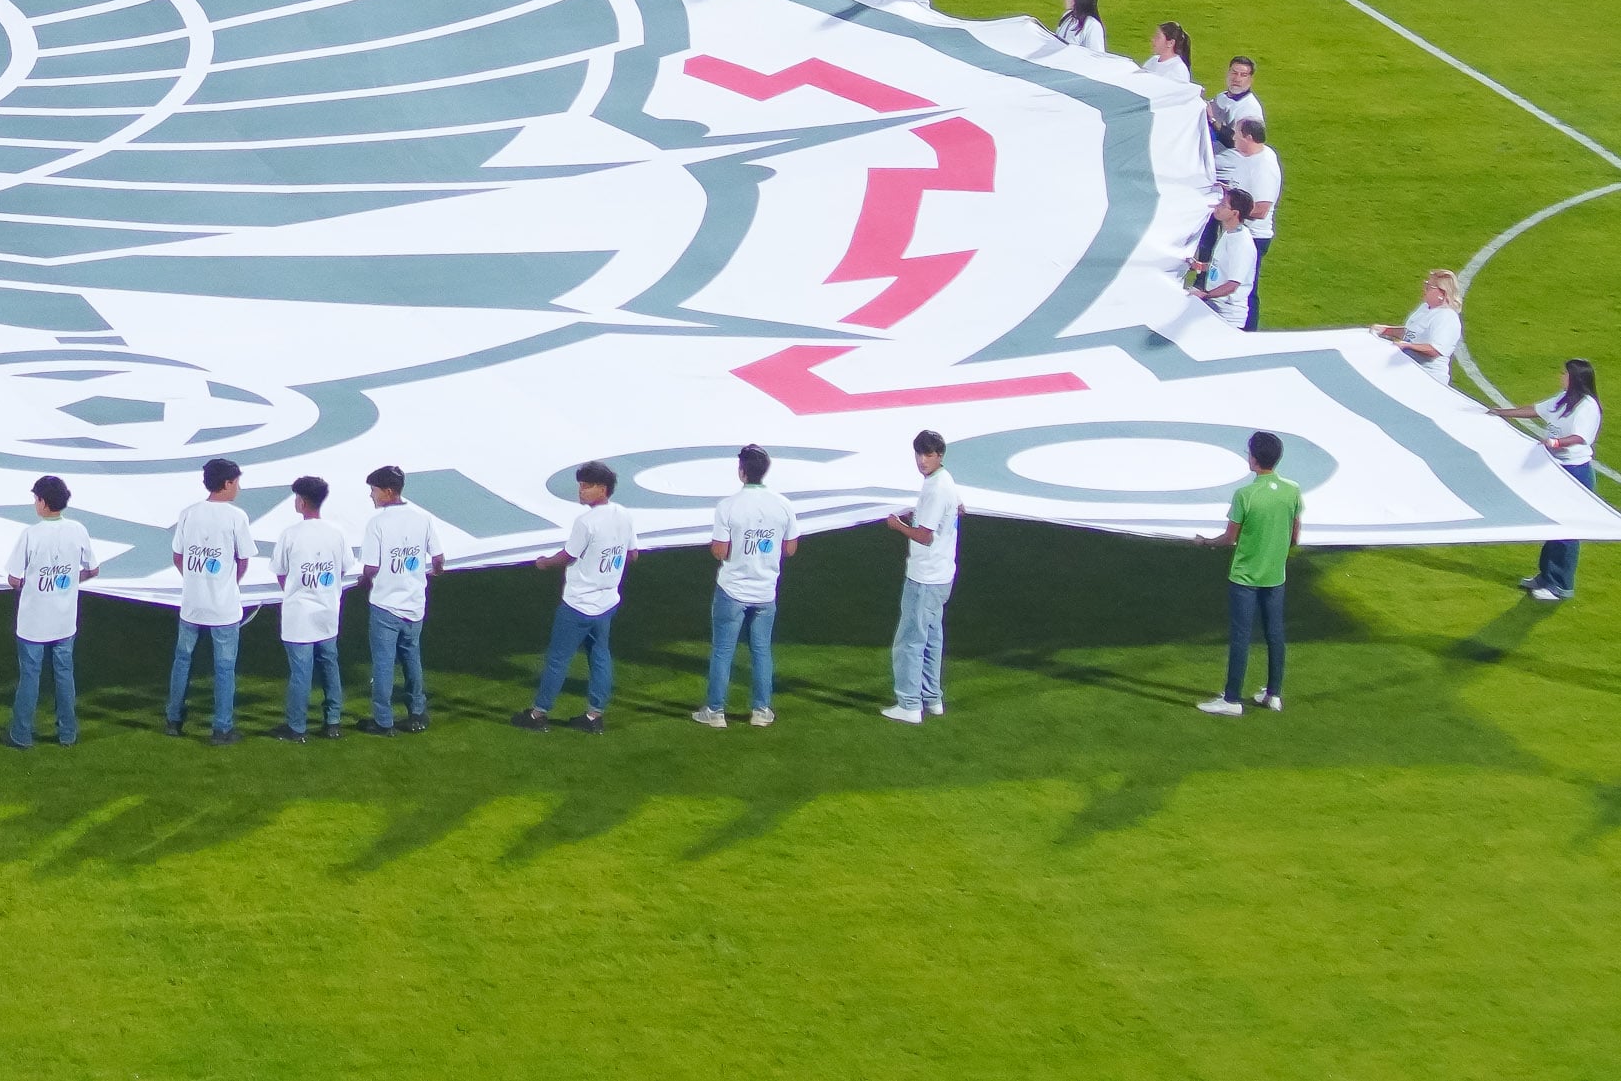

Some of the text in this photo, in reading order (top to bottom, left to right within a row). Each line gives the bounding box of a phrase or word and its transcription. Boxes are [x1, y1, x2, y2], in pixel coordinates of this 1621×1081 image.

[188, 545, 222, 557] SOMOS
[601, 545, 624, 559] SMOS
[39, 564, 71, 576] SOMOS
[300, 561, 334, 573] SOMOS
